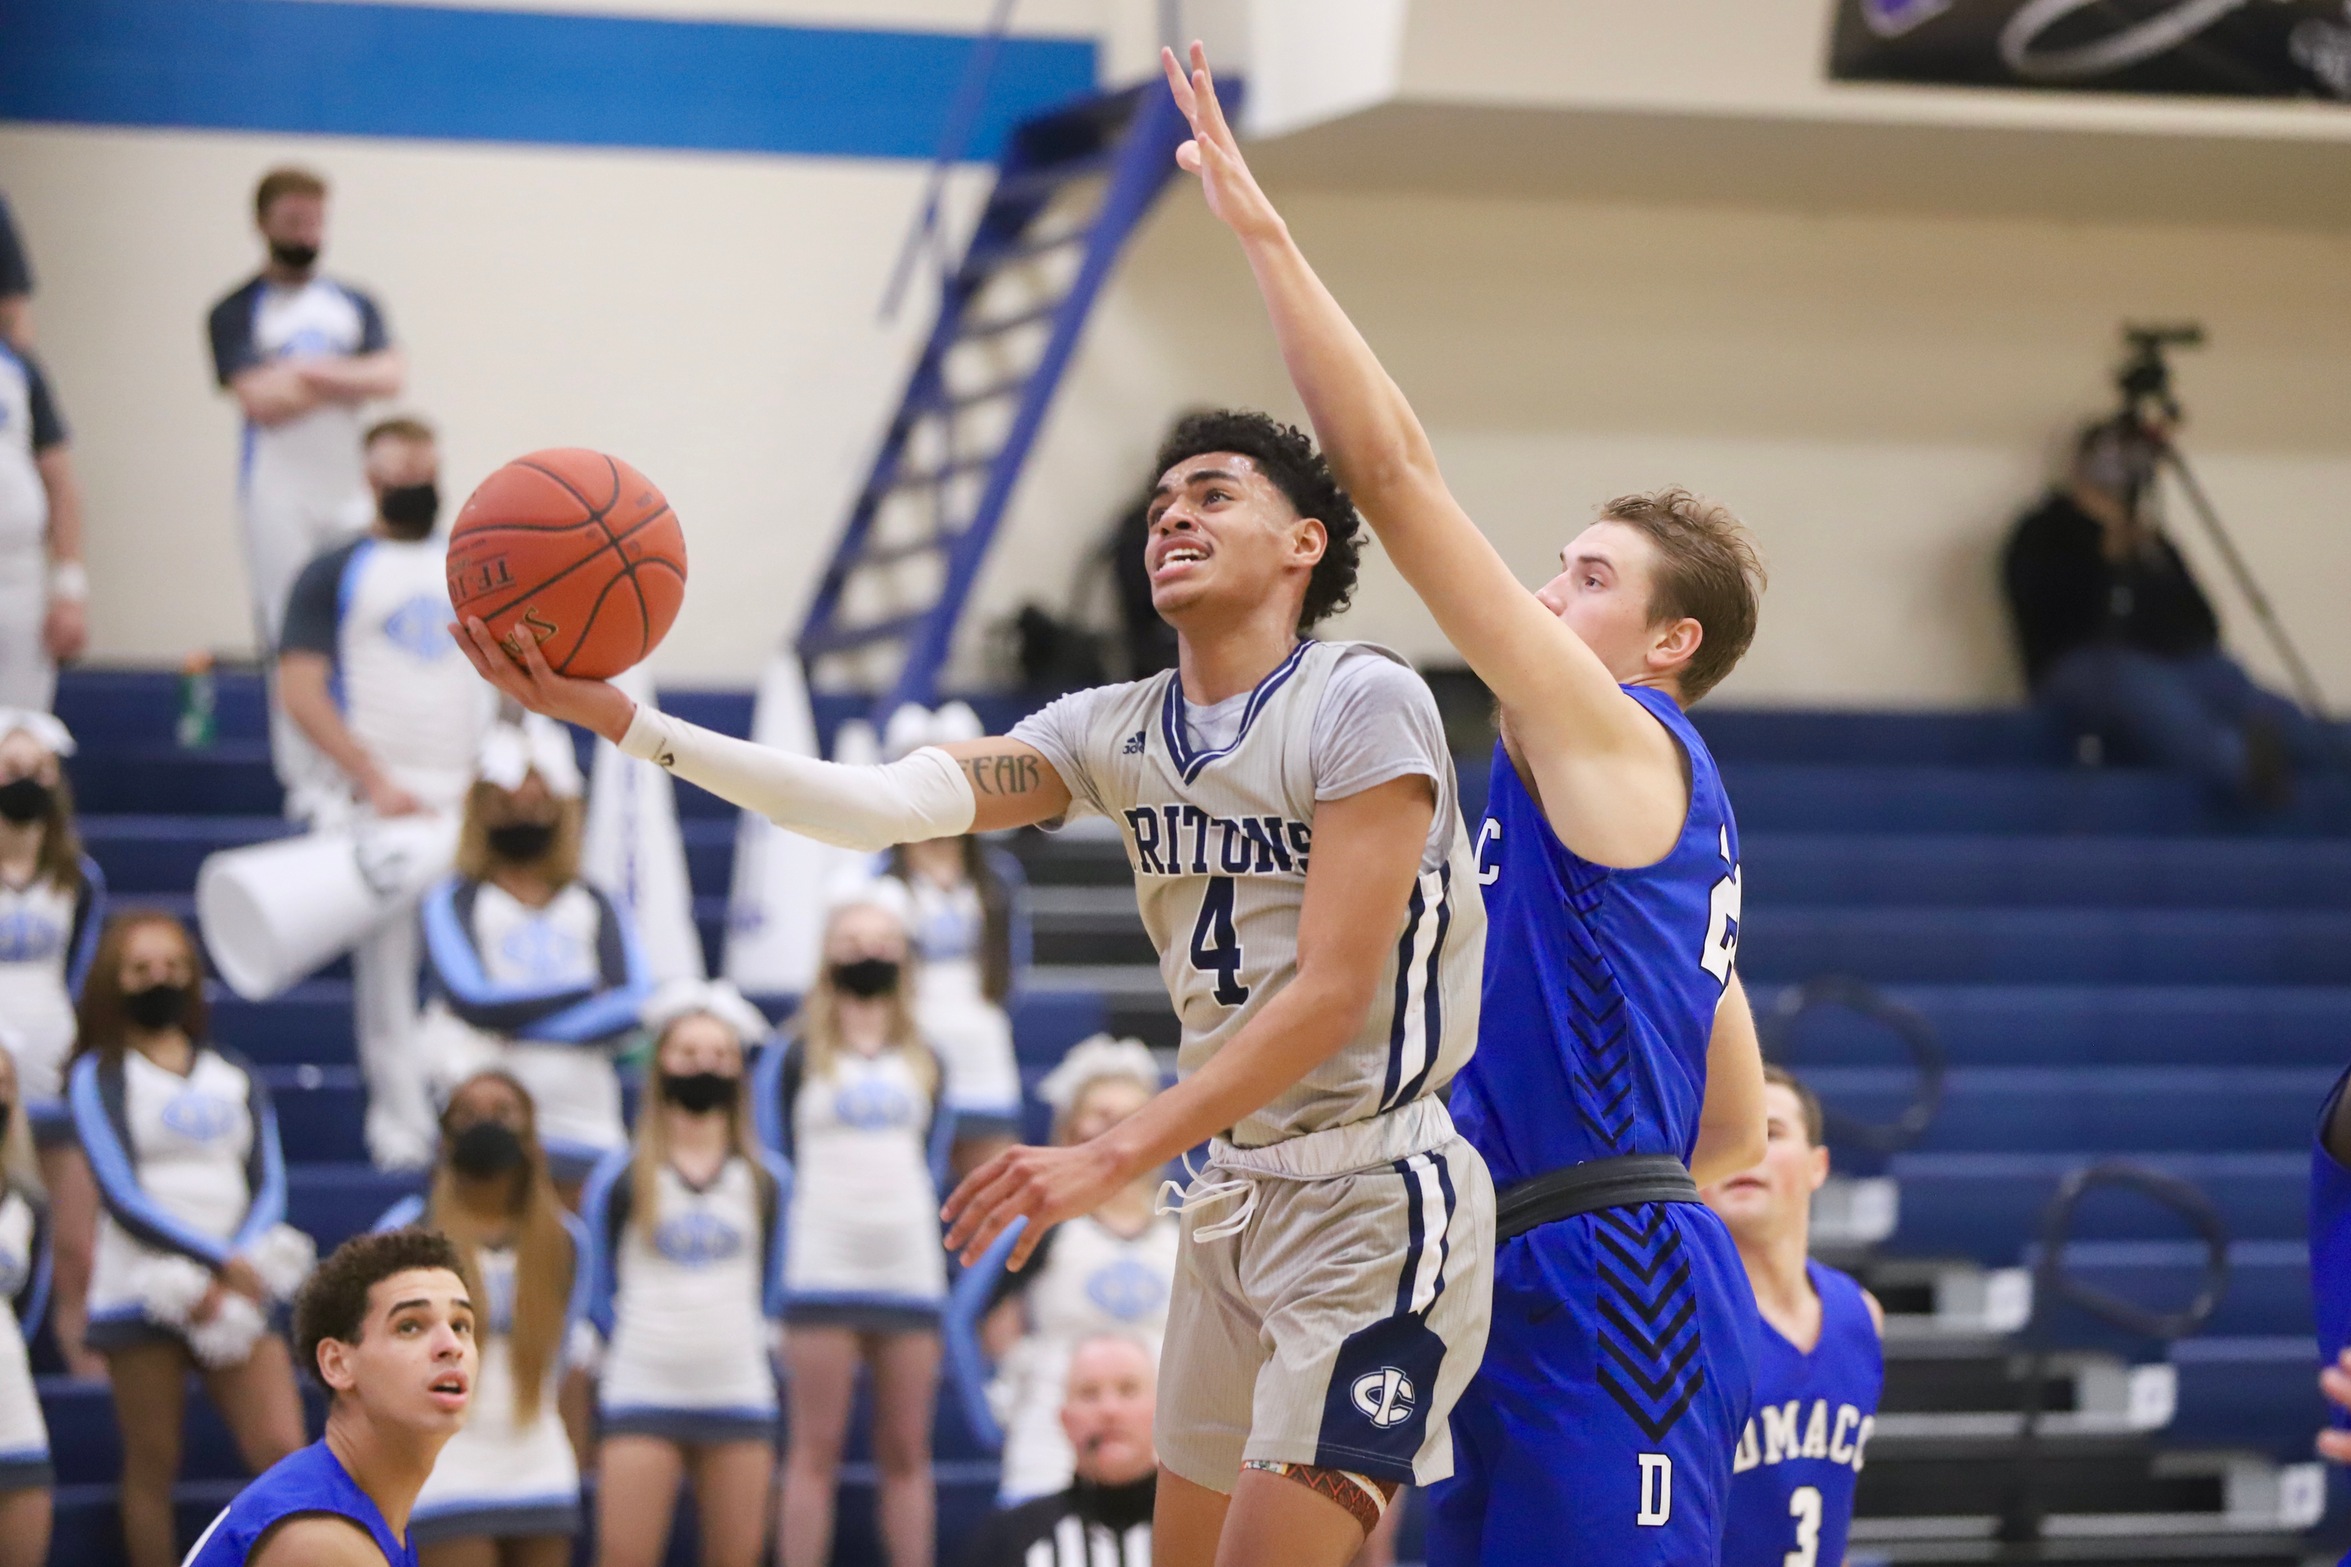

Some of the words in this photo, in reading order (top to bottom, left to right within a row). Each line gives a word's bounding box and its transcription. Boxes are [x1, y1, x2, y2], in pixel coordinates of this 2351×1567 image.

[1190, 876, 1250, 1007] 4
[1636, 1452, 1672, 1527] D
[1783, 1486, 1823, 1567] 3
